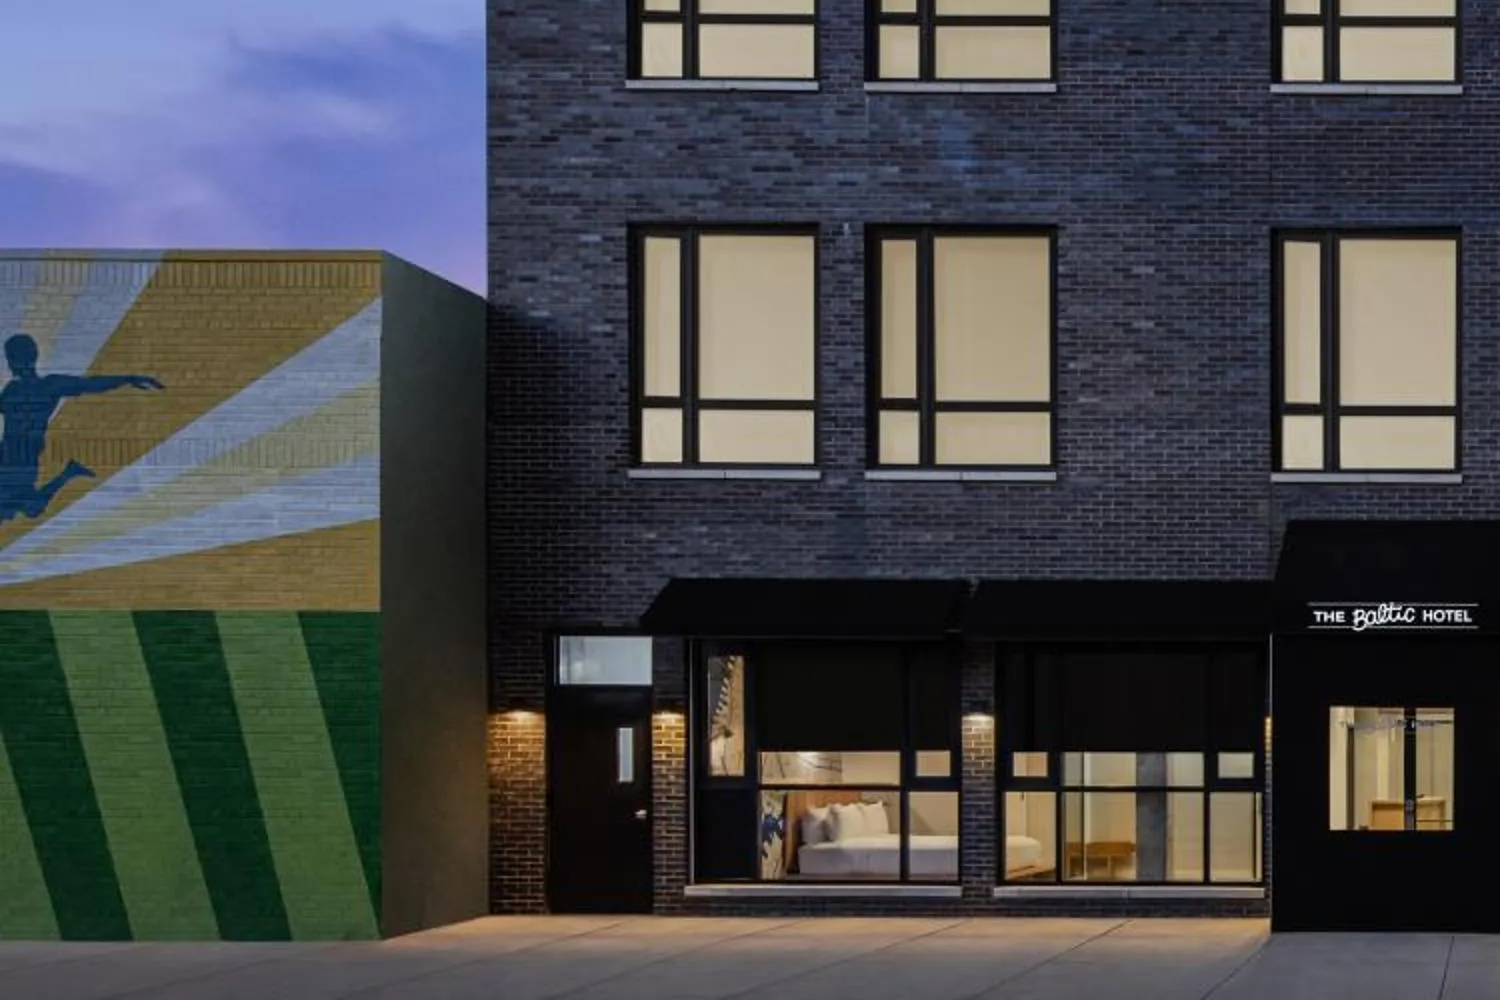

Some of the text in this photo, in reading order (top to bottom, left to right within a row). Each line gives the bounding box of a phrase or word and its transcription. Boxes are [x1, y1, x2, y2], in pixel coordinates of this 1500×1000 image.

[1313, 602, 1473, 632] THE Baltic HOTEL
